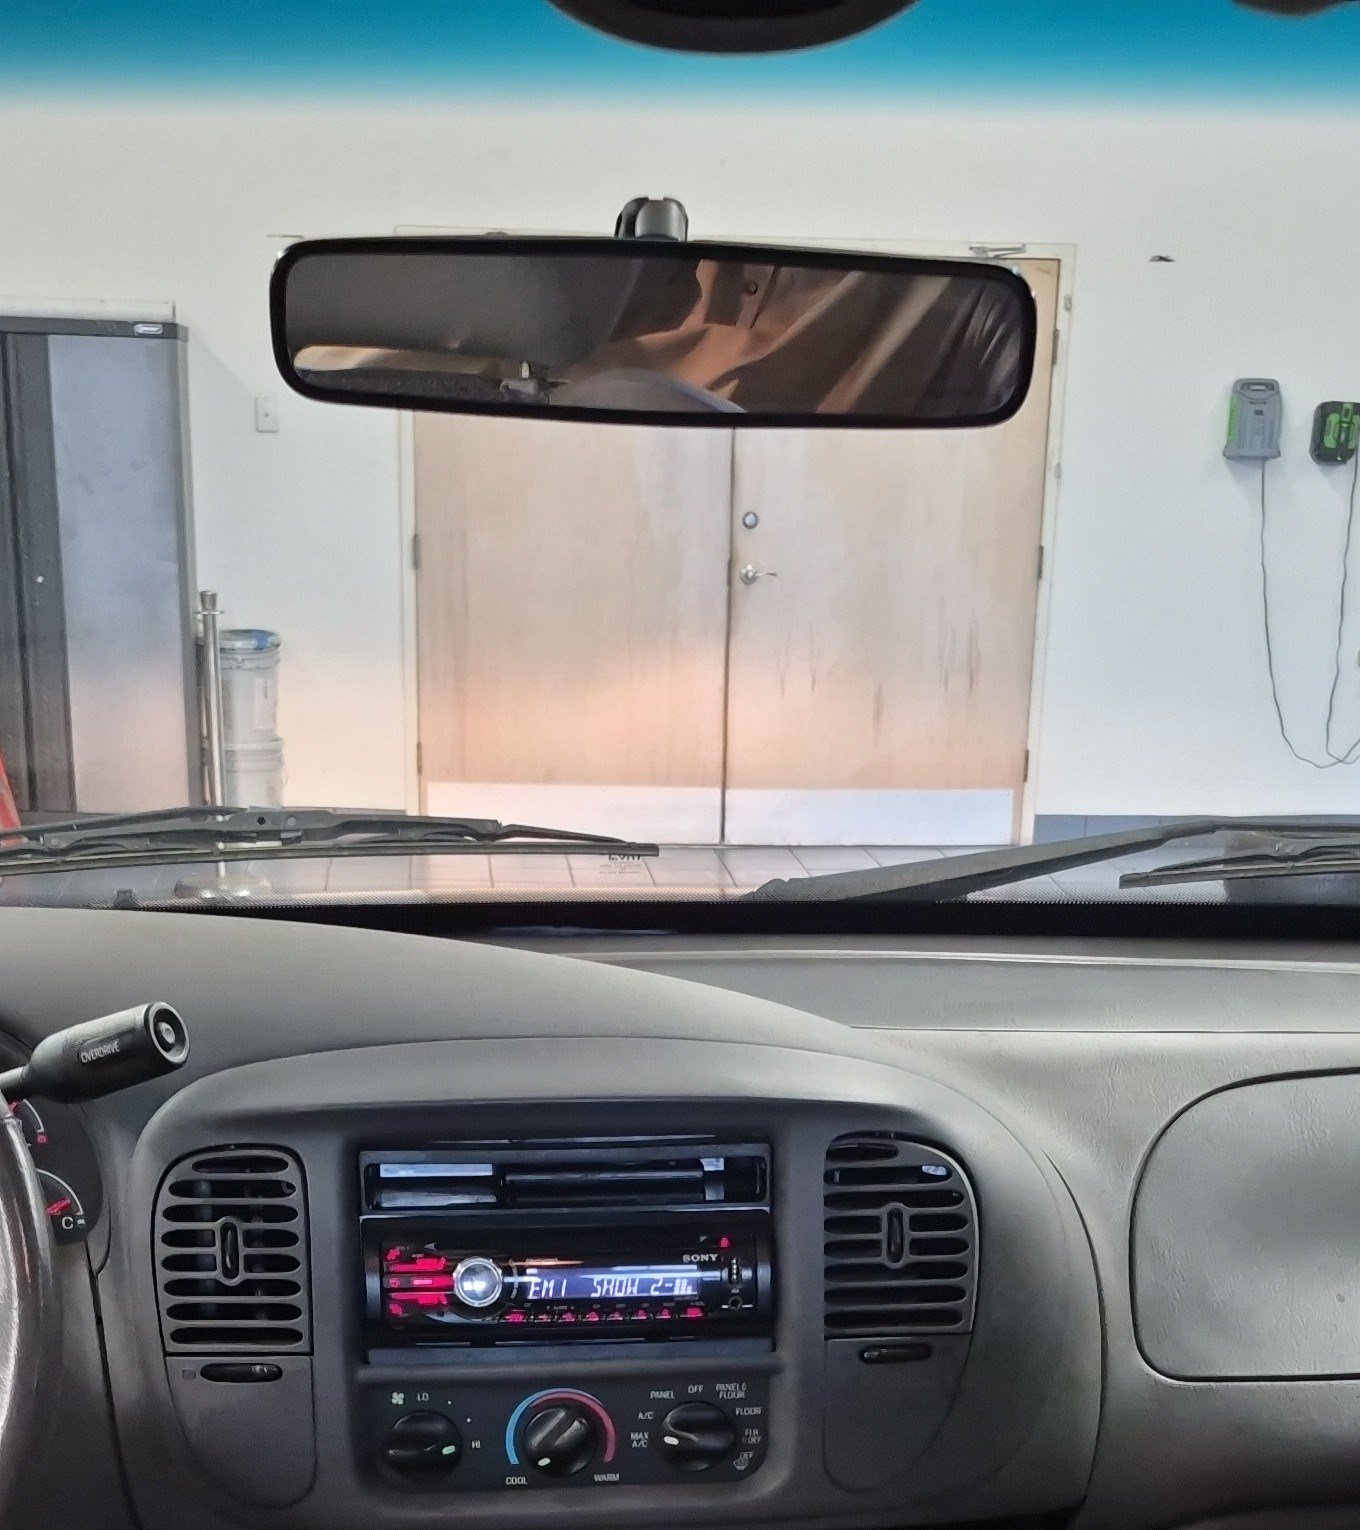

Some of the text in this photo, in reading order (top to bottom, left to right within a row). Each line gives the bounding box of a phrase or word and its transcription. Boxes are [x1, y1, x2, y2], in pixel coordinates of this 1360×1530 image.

[80, 1041, 121, 1064] OVERDRIVE
[61, 1216, 74, 1230] C
[682, 1254, 719, 1263] SONY
[688, 1384, 704, 1394] OFF
[417, 1392, 429, 1402] LO
[650, 1390, 674, 1399] PANEL
[638, 1411, 654, 1420] A/C
[735, 1407, 761, 1415] FLOOR
[630, 1431, 649, 1440] MAX
[471, 1440, 481, 1449] HI
[631, 1440, 648, 1448] A/C
[505, 1476, 528, 1486] COOL
[593, 1473, 620, 1482] WARM
